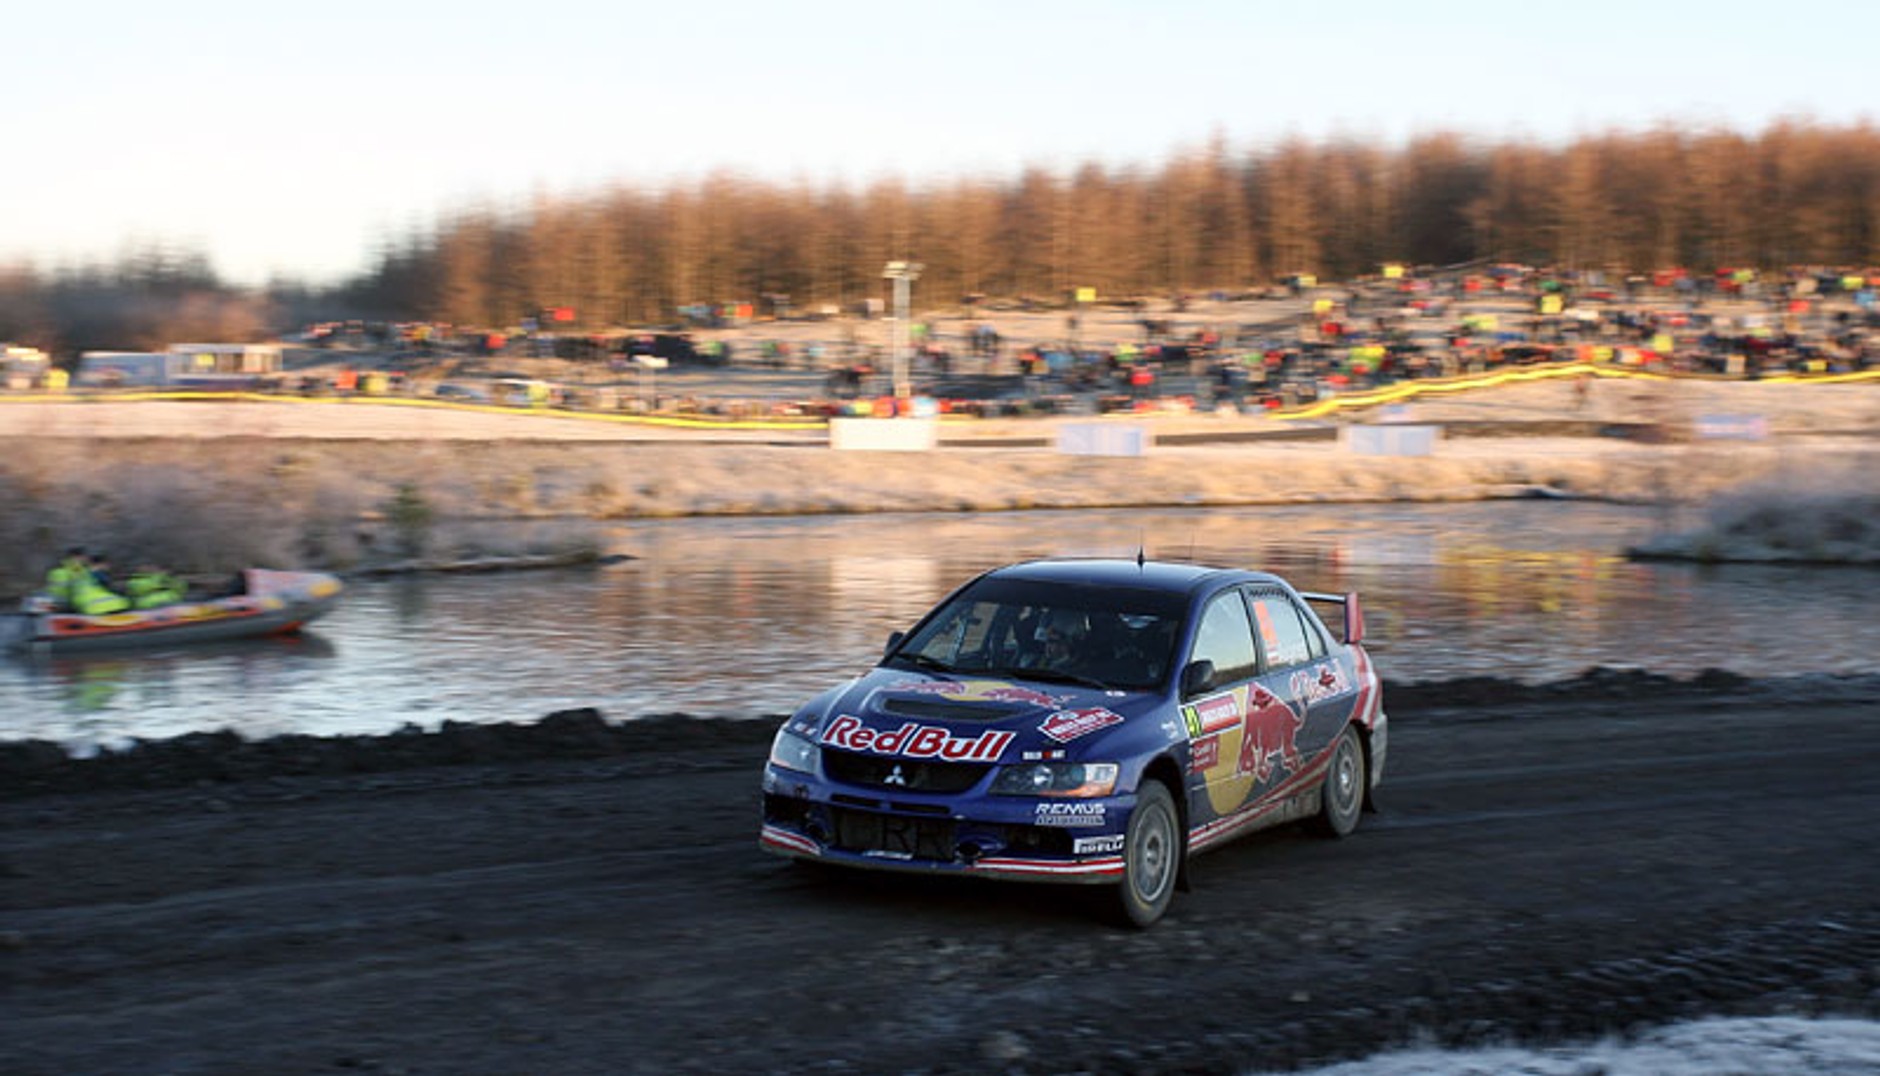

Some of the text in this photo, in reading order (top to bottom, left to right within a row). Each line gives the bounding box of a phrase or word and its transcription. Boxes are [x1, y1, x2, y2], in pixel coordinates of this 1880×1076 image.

[822, 714, 919, 755] Red
[902, 725, 1016, 761] Bull
[1034, 803, 1106, 814] REMUS
